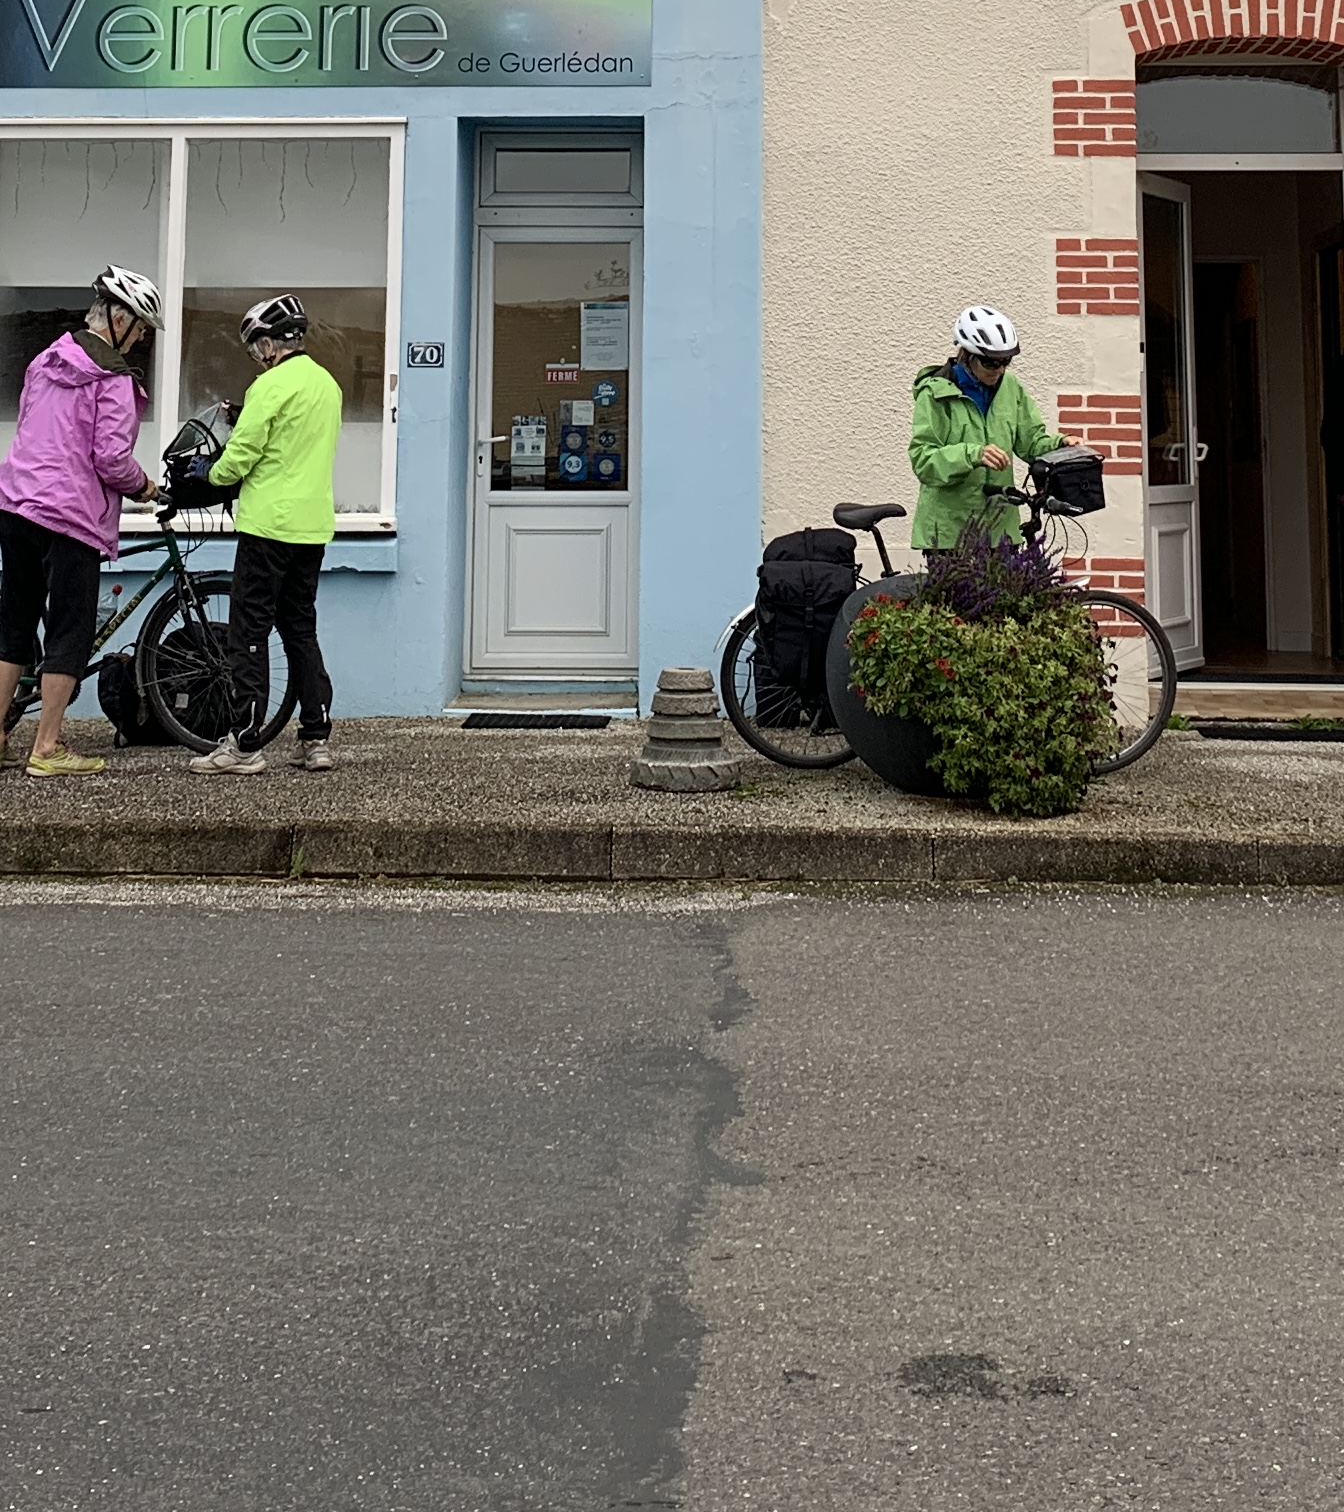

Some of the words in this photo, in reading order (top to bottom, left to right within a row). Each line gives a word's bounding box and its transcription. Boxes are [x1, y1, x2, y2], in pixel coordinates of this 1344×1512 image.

[457, 52, 491, 73] de
[499, 51, 634, 74] Guerlédan
[413, 346, 439, 364] 70
[547, 370, 578, 382] FERMÉ
